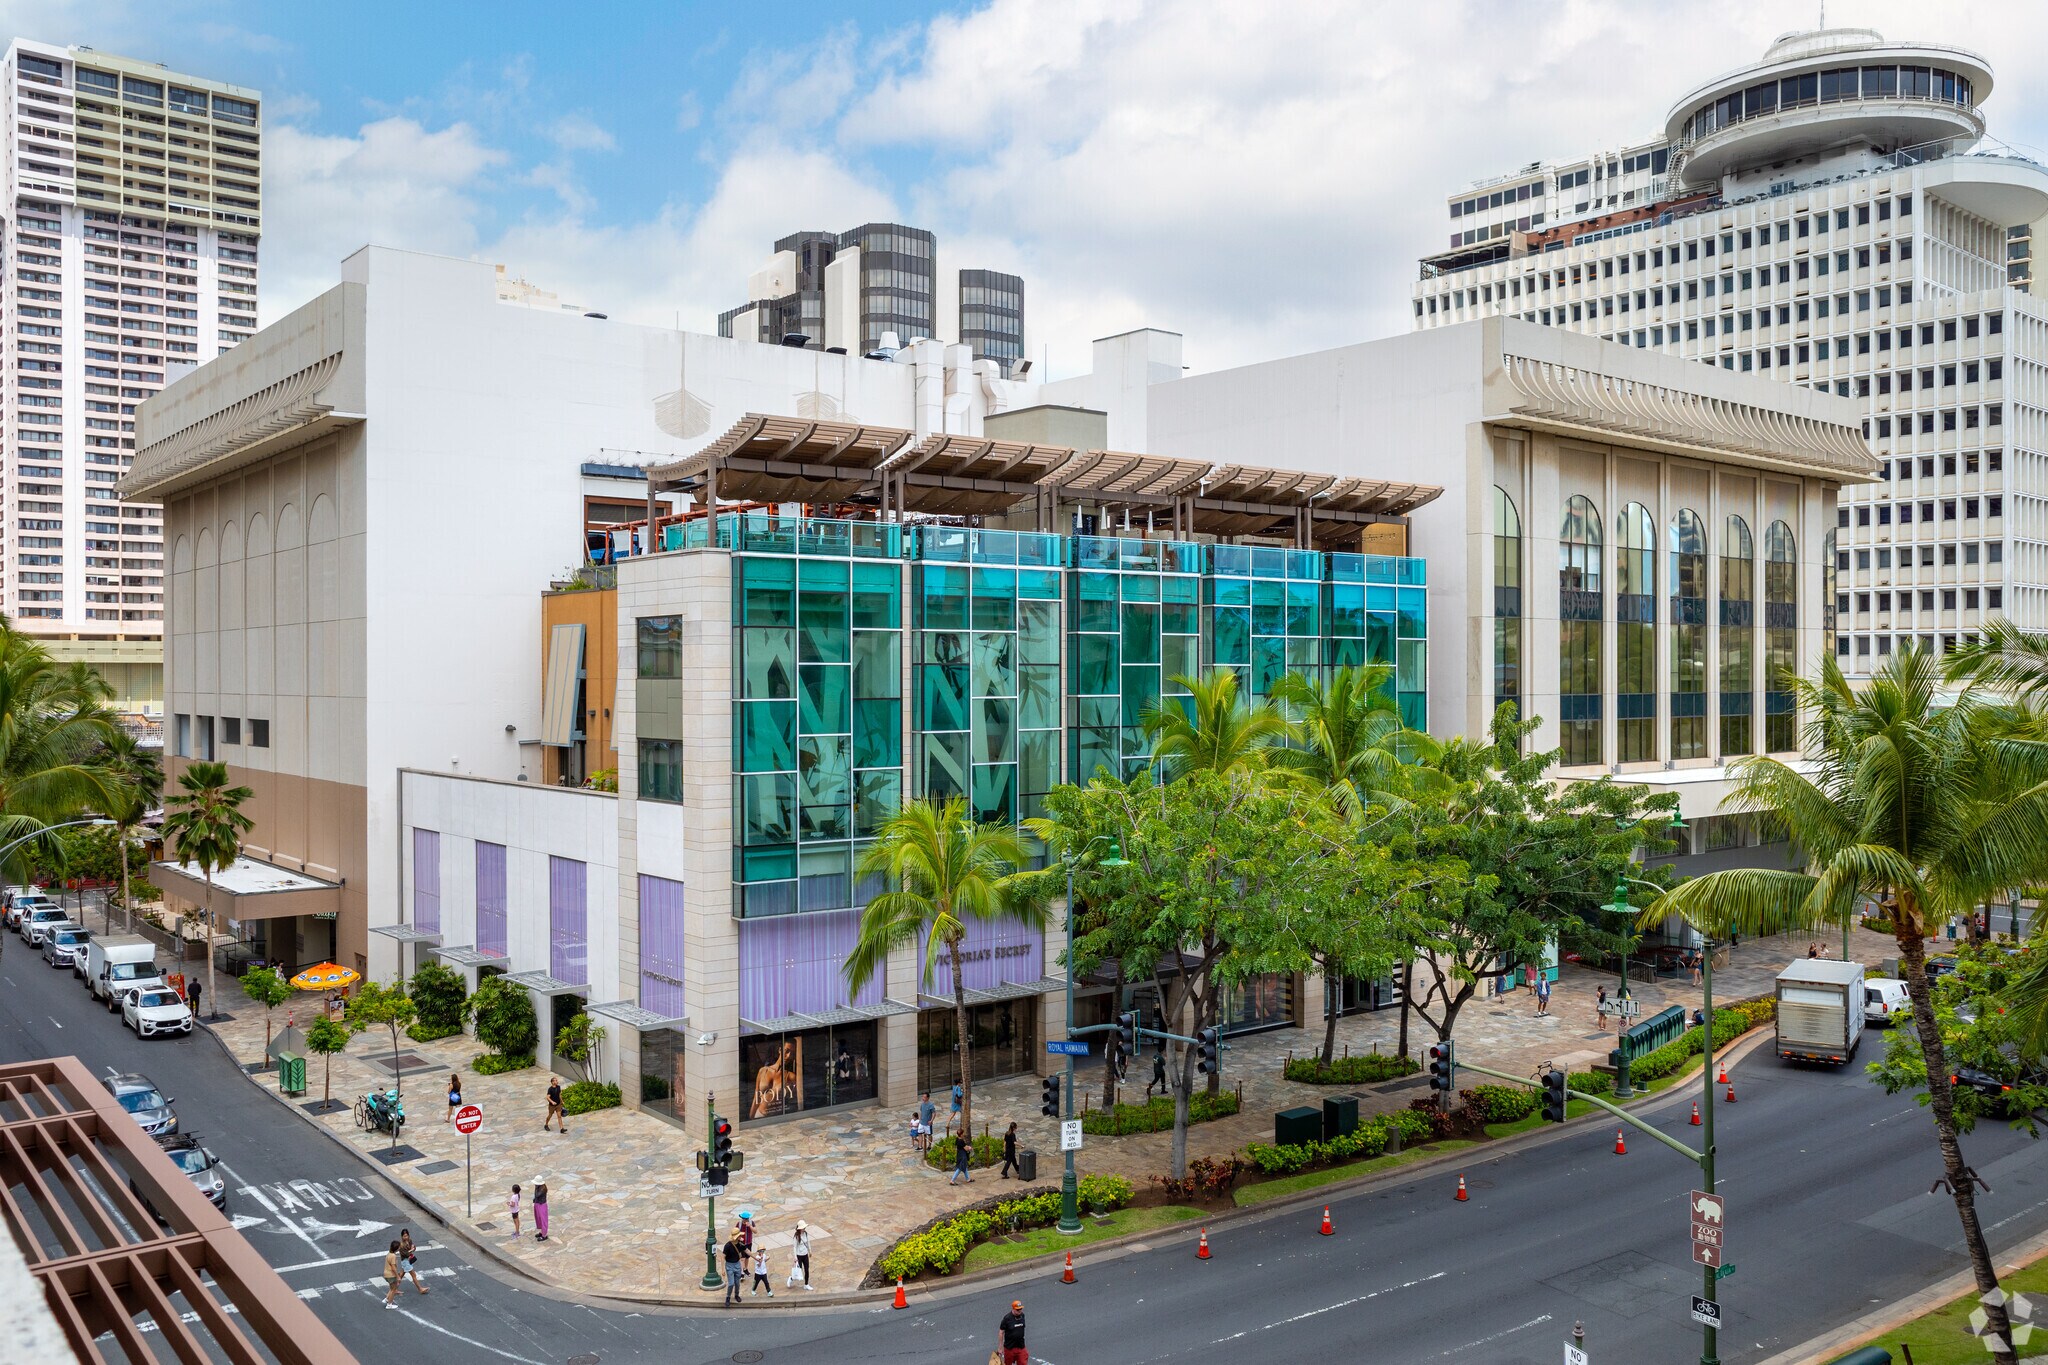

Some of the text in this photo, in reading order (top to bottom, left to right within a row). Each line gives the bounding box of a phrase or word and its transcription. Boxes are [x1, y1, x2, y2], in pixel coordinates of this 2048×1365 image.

[995, 943, 1032, 959] SECRET
[1048, 1043, 1088, 1053] ROYAL HAWAIIAN
[755, 1084, 796, 1104] BODY
[461, 1122, 477, 1130] ENTER
[1697, 1226, 1717, 1237] ZOO
[1693, 1312, 1719, 1327] BIKE LANE
[1571, 1349, 1581, 1362] NO
